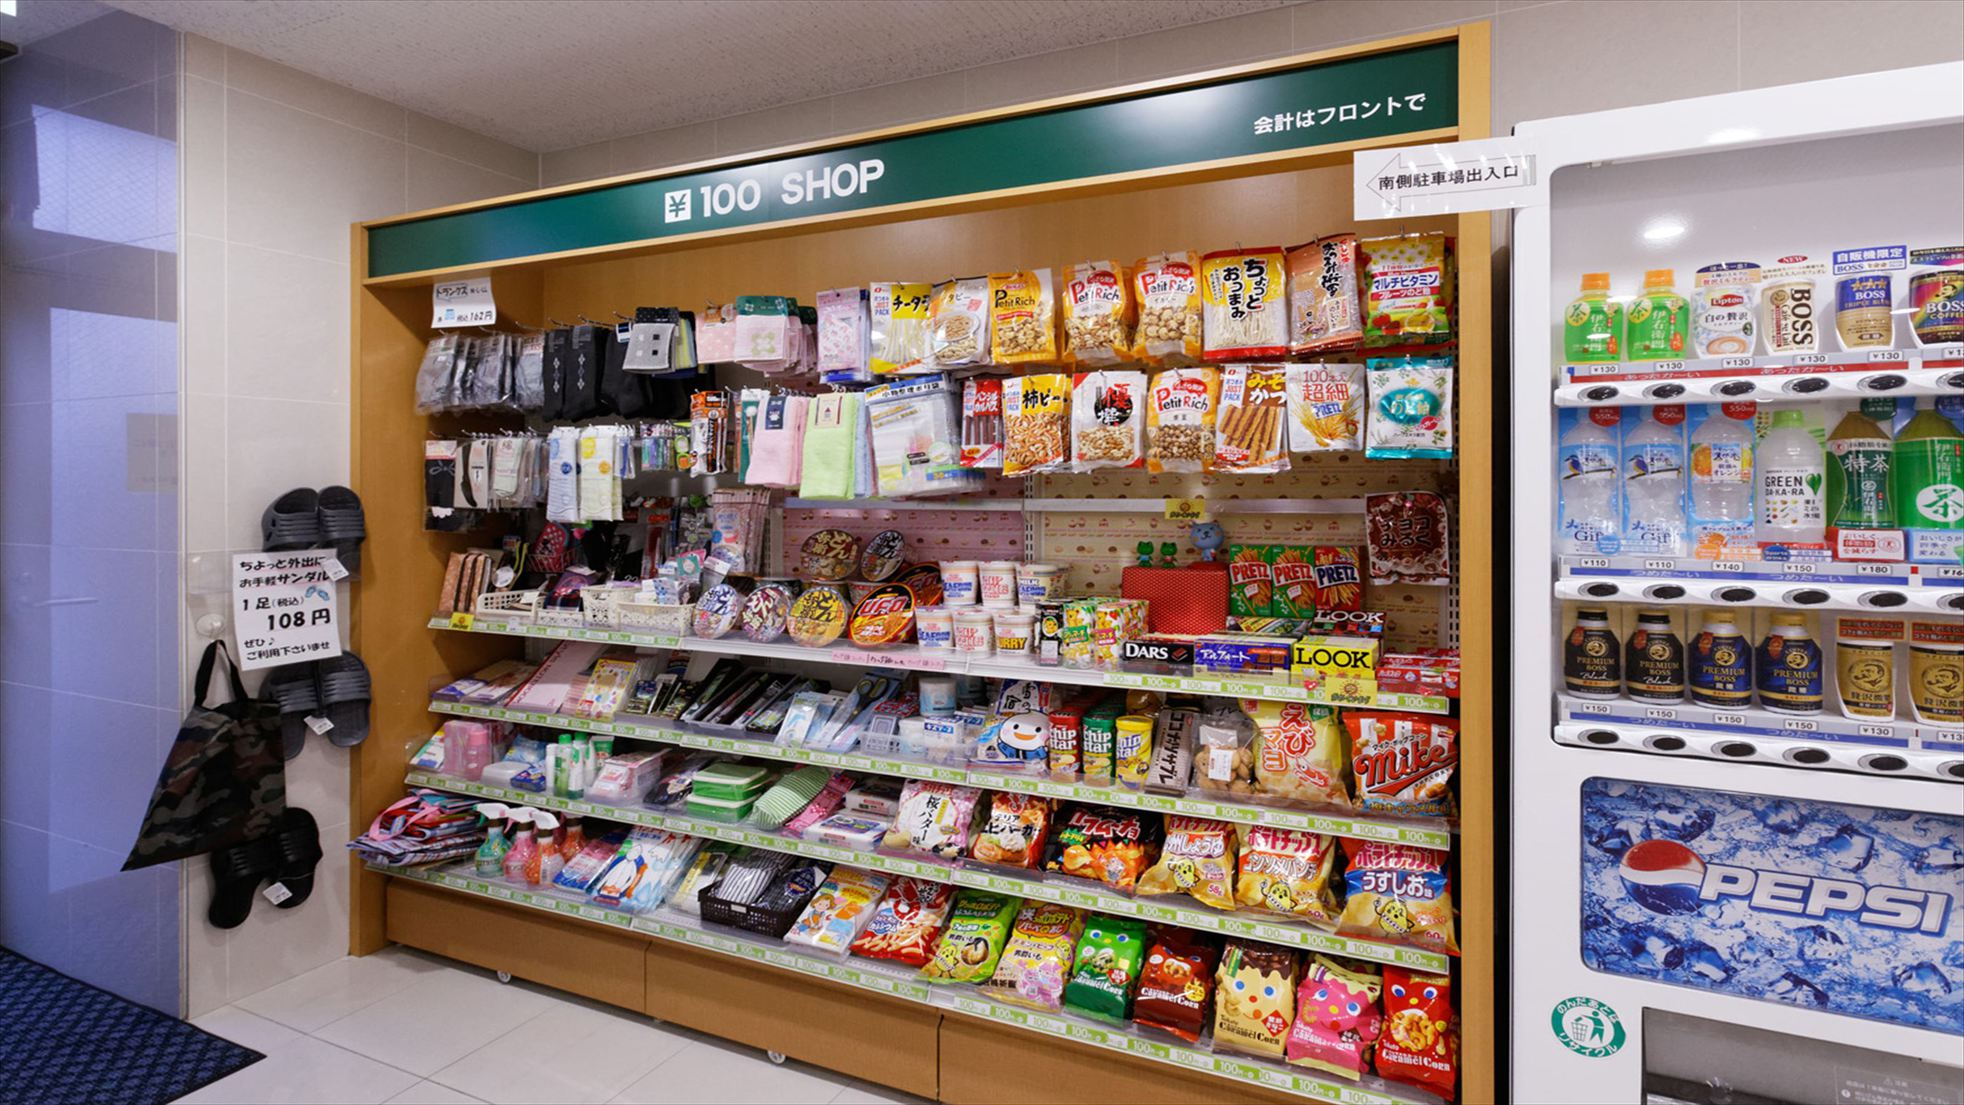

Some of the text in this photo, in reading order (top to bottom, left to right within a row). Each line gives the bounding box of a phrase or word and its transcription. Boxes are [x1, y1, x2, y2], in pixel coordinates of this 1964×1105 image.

[1253, 92, 1427, 136] 会計はフロントで
[700, 179, 762, 218] 100
[780, 158, 885, 205] SHOP
[1378, 164, 1518, 192] 南側駐車場出入口
[1836, 247, 1903, 264] 自販機限定
[1836, 262, 1864, 273] BOSS
[1373, 274, 1439, 290] マルチビタミン
[1014, 294, 1035, 307] Rich
[1712, 294, 1744, 306] Lipton
[1855, 290, 1886, 301] BOSS
[1790, 288, 1814, 346] BOSS
[1155, 387, 1182, 411] Petit
[1183, 395, 1208, 411] Rich
[1302, 383, 1350, 403] 超細
[1844, 453, 1889, 474] 特茶
[1764, 475, 1804, 488] GREEN
[1921, 487, 1964, 518] 茶
[1379, 532, 1433, 547] みるく
[239, 556, 326, 572] ちょっと外出に
[1231, 563, 1270, 583] PRETZ
[1273, 564, 1313, 584] PRETZ
[239, 570, 330, 588] お手軽サンダル
[1316, 565, 1358, 587] PRETZ
[267, 607, 331, 631] 108 円
[1314, 609, 1385, 623] LOOK
[246, 641, 331, 661] ご利用下さいませ
[1125, 642, 1169, 661] DARS
[1295, 647, 1371, 669] LOOK
[1281, 703, 1316, 757] えび
[1362, 871, 1435, 899] うすしお味
[1699, 863, 1950, 934] PEPSI
[1177, 996, 1200, 1010] Corn
[1218, 1021, 1256, 1040] Caramel
[1256, 1033, 1281, 1047] Corn
[1381, 1048, 1451, 1072] Caramel Corn
